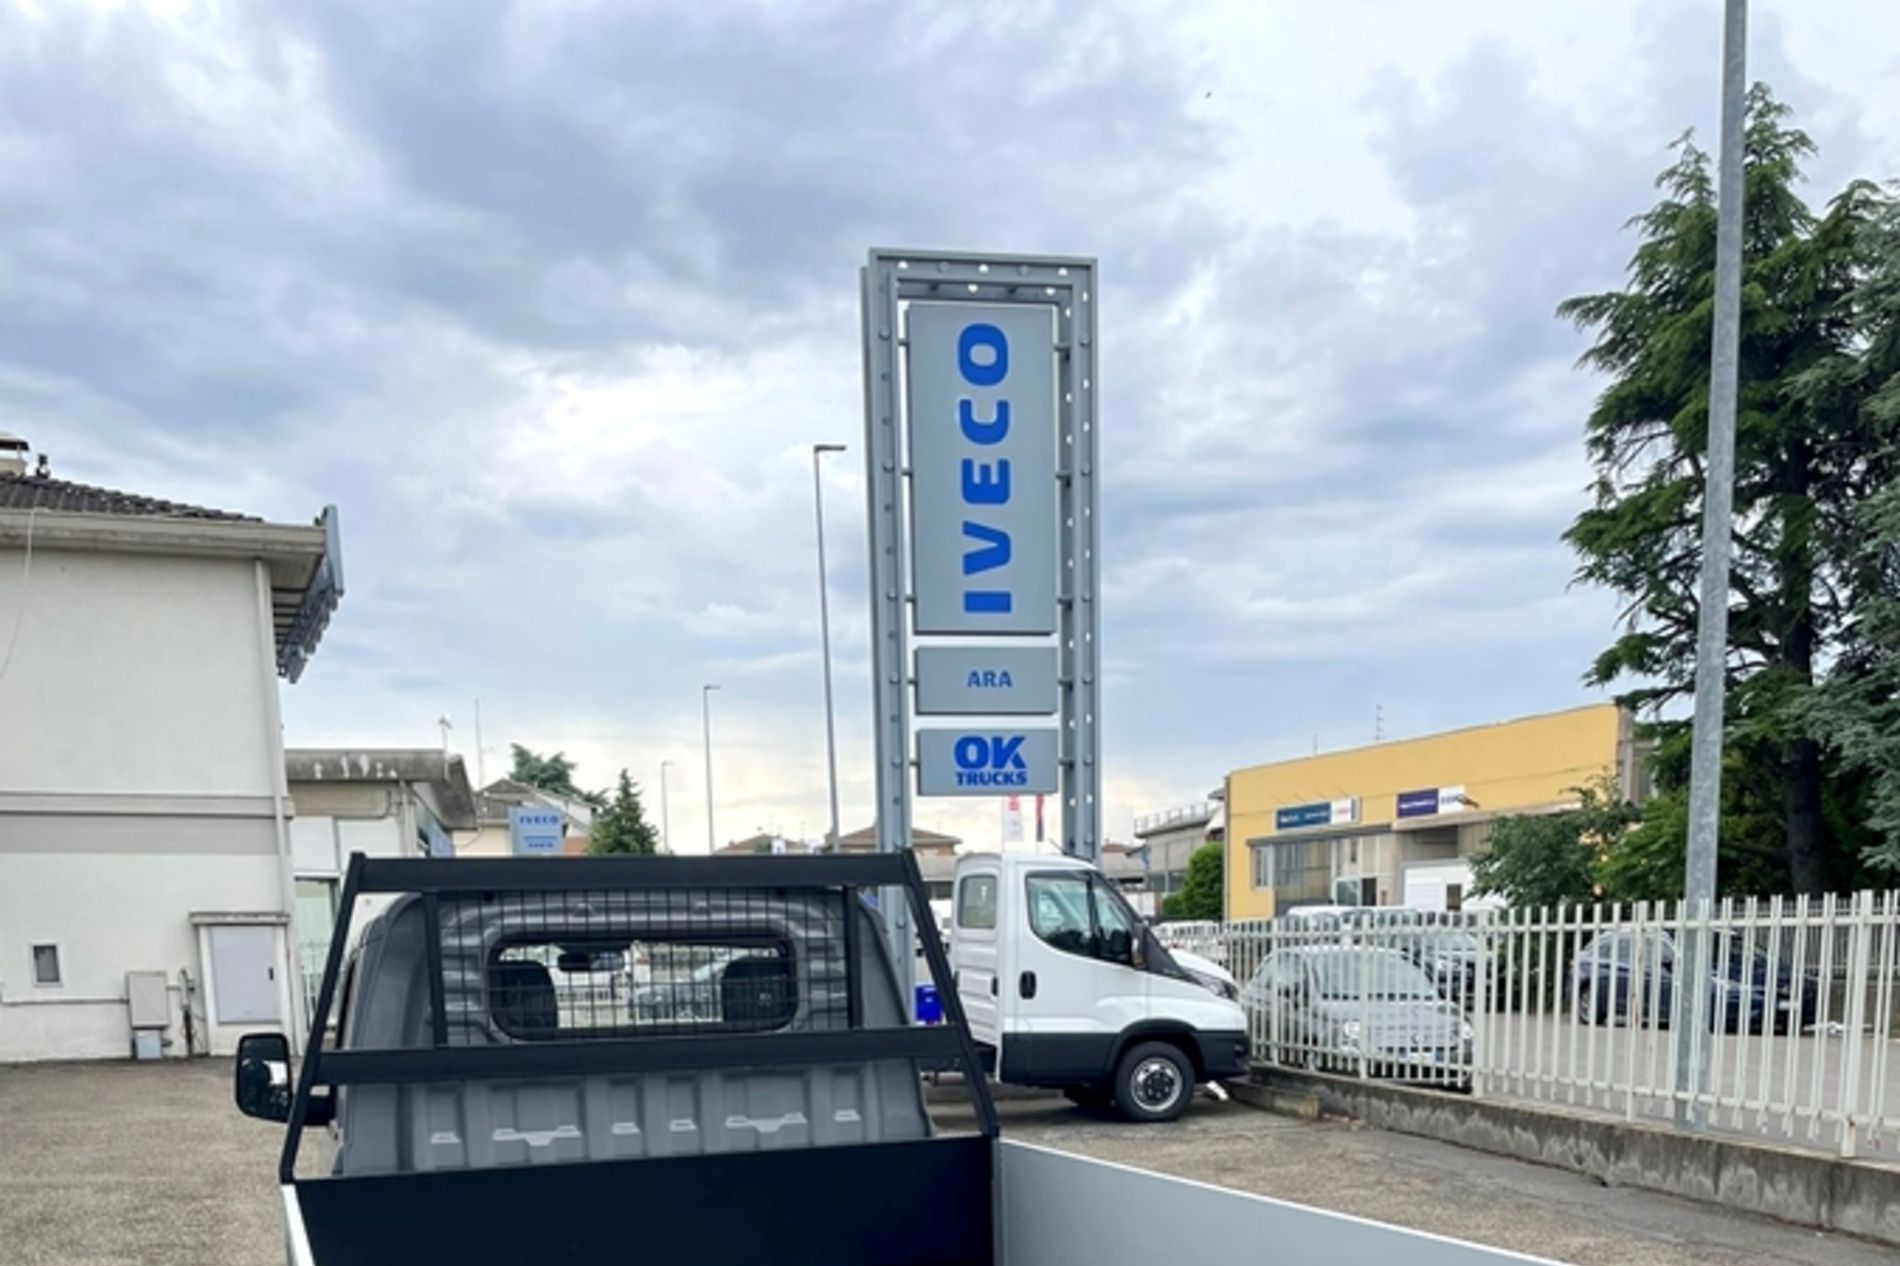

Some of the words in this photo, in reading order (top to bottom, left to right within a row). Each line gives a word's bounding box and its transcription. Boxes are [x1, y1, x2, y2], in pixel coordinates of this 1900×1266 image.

[957, 322, 1012, 614] IVECO
[967, 669, 1012, 688] ARA
[954, 735, 1026, 769] OK
[955, 771, 1028, 786] TRUCKS
